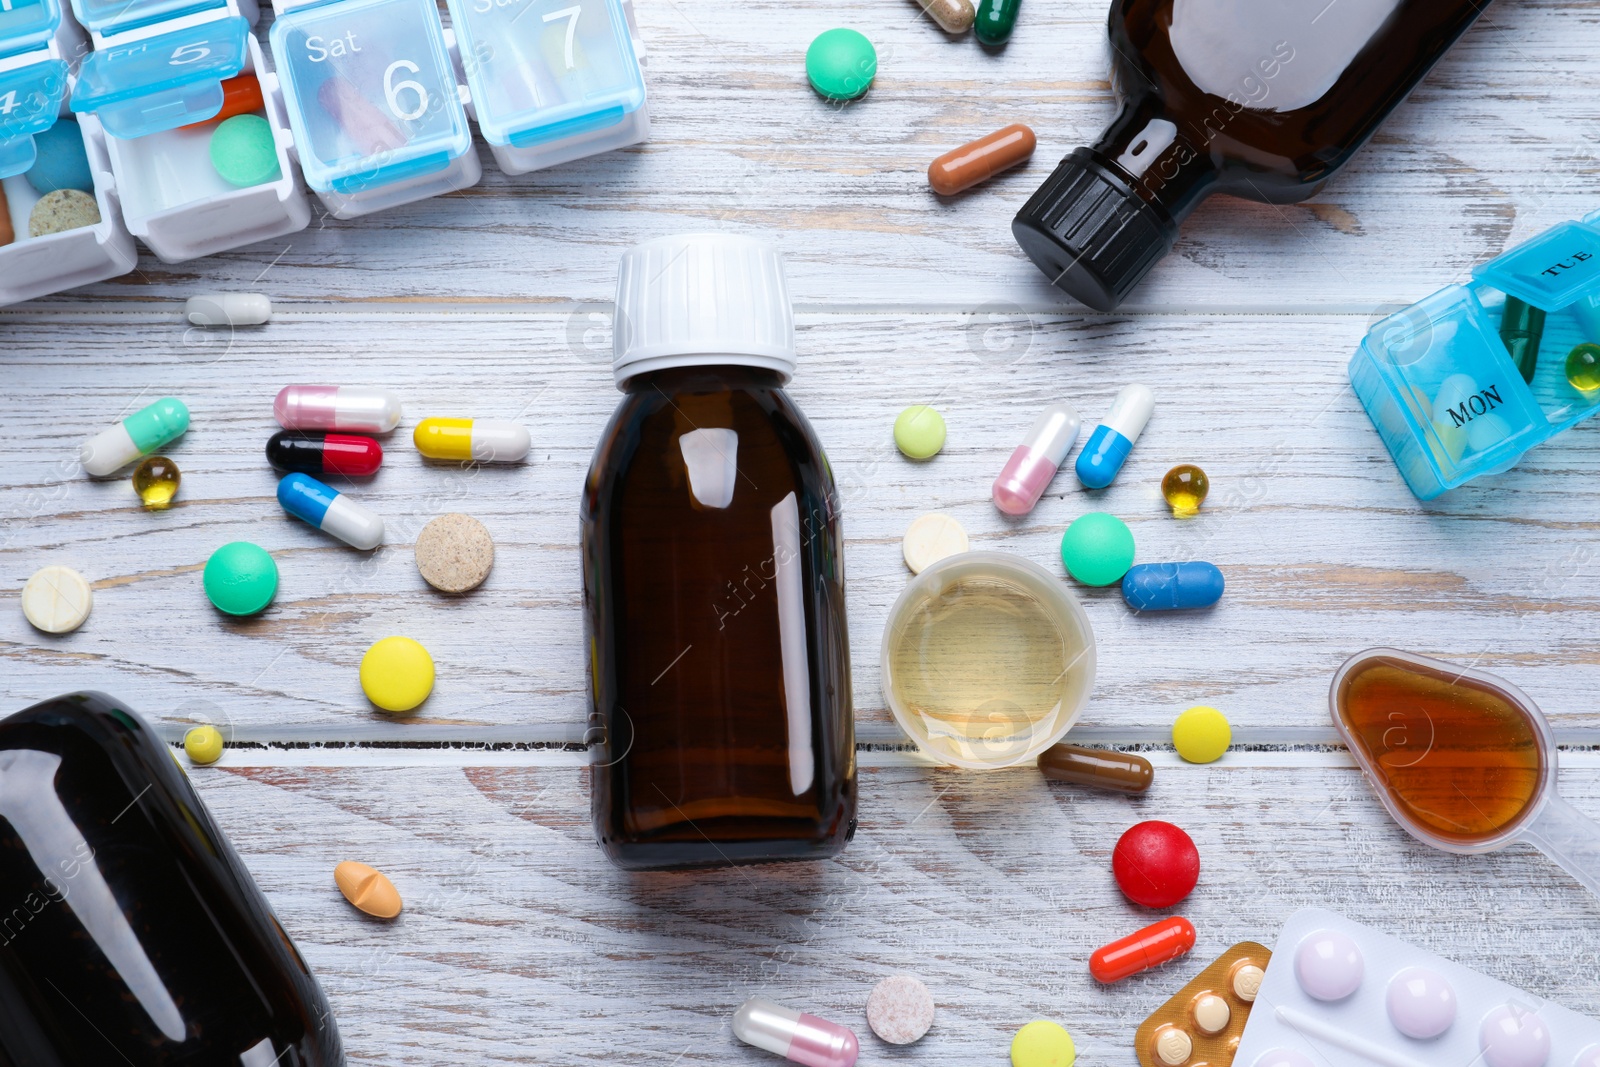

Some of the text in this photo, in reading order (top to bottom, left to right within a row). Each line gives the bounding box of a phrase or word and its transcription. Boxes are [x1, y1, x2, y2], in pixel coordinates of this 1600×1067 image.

[107, 40, 211, 66] Fri 5
[305, 30, 362, 63] Sat
[542, 5, 582, 70] 7
[383, 59, 429, 121] 6
[1541, 250, 1593, 277] TUE
[1446, 384, 1504, 429] MON
